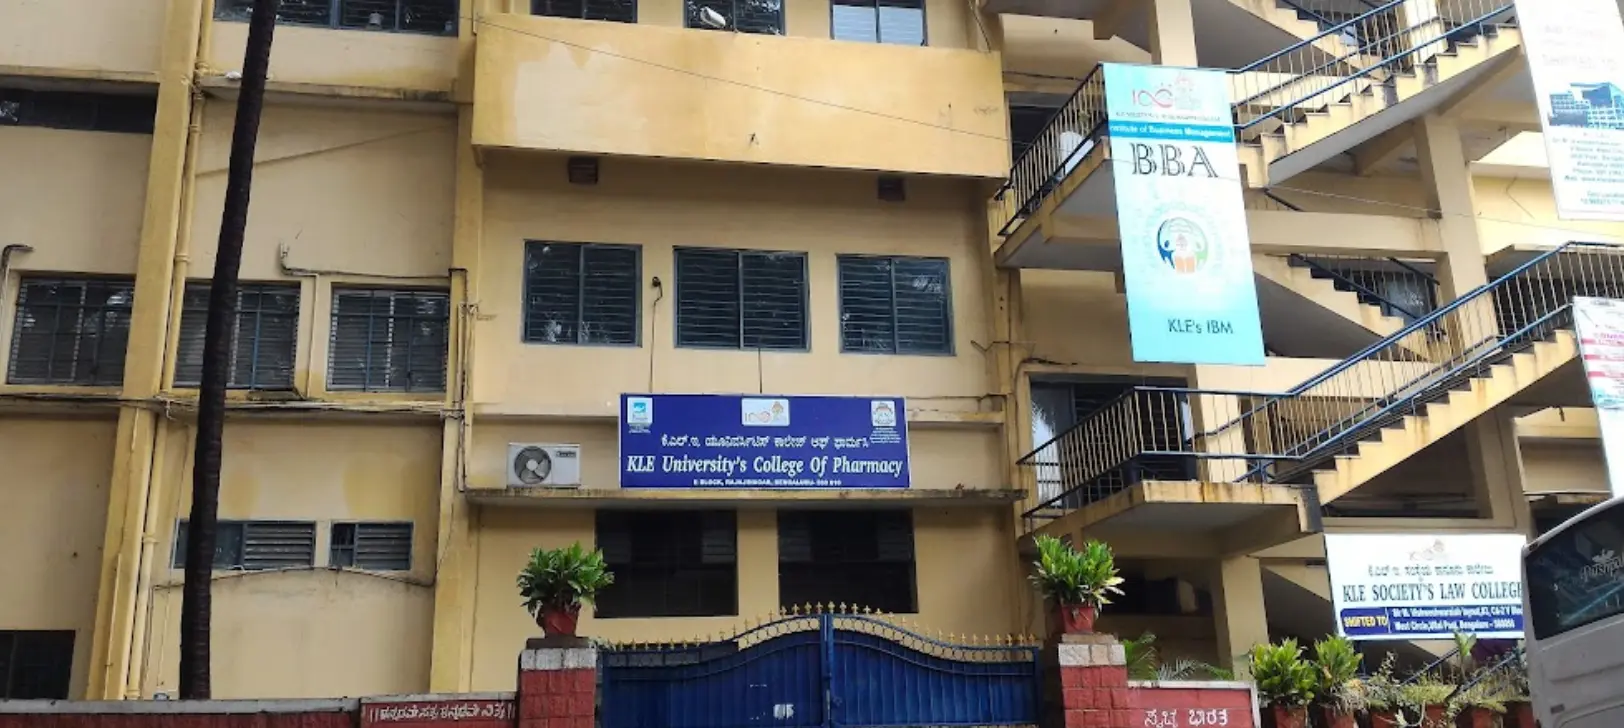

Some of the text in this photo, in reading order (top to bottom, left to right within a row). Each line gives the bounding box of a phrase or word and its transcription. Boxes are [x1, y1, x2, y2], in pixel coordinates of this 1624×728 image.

[1184, 127, 1231, 138] Management
[1129, 142, 1219, 178] BBA
[1167, 318, 1234, 335] KLE's IBM
[626, 454, 904, 478] KLE University's College Of Pharmacy
[1342, 584, 1366, 602] KLE
[1372, 582, 1434, 601] SOCIETY'S
[1440, 583, 1465, 600] LAW
[1344, 616, 1375, 628] SHIFTED
